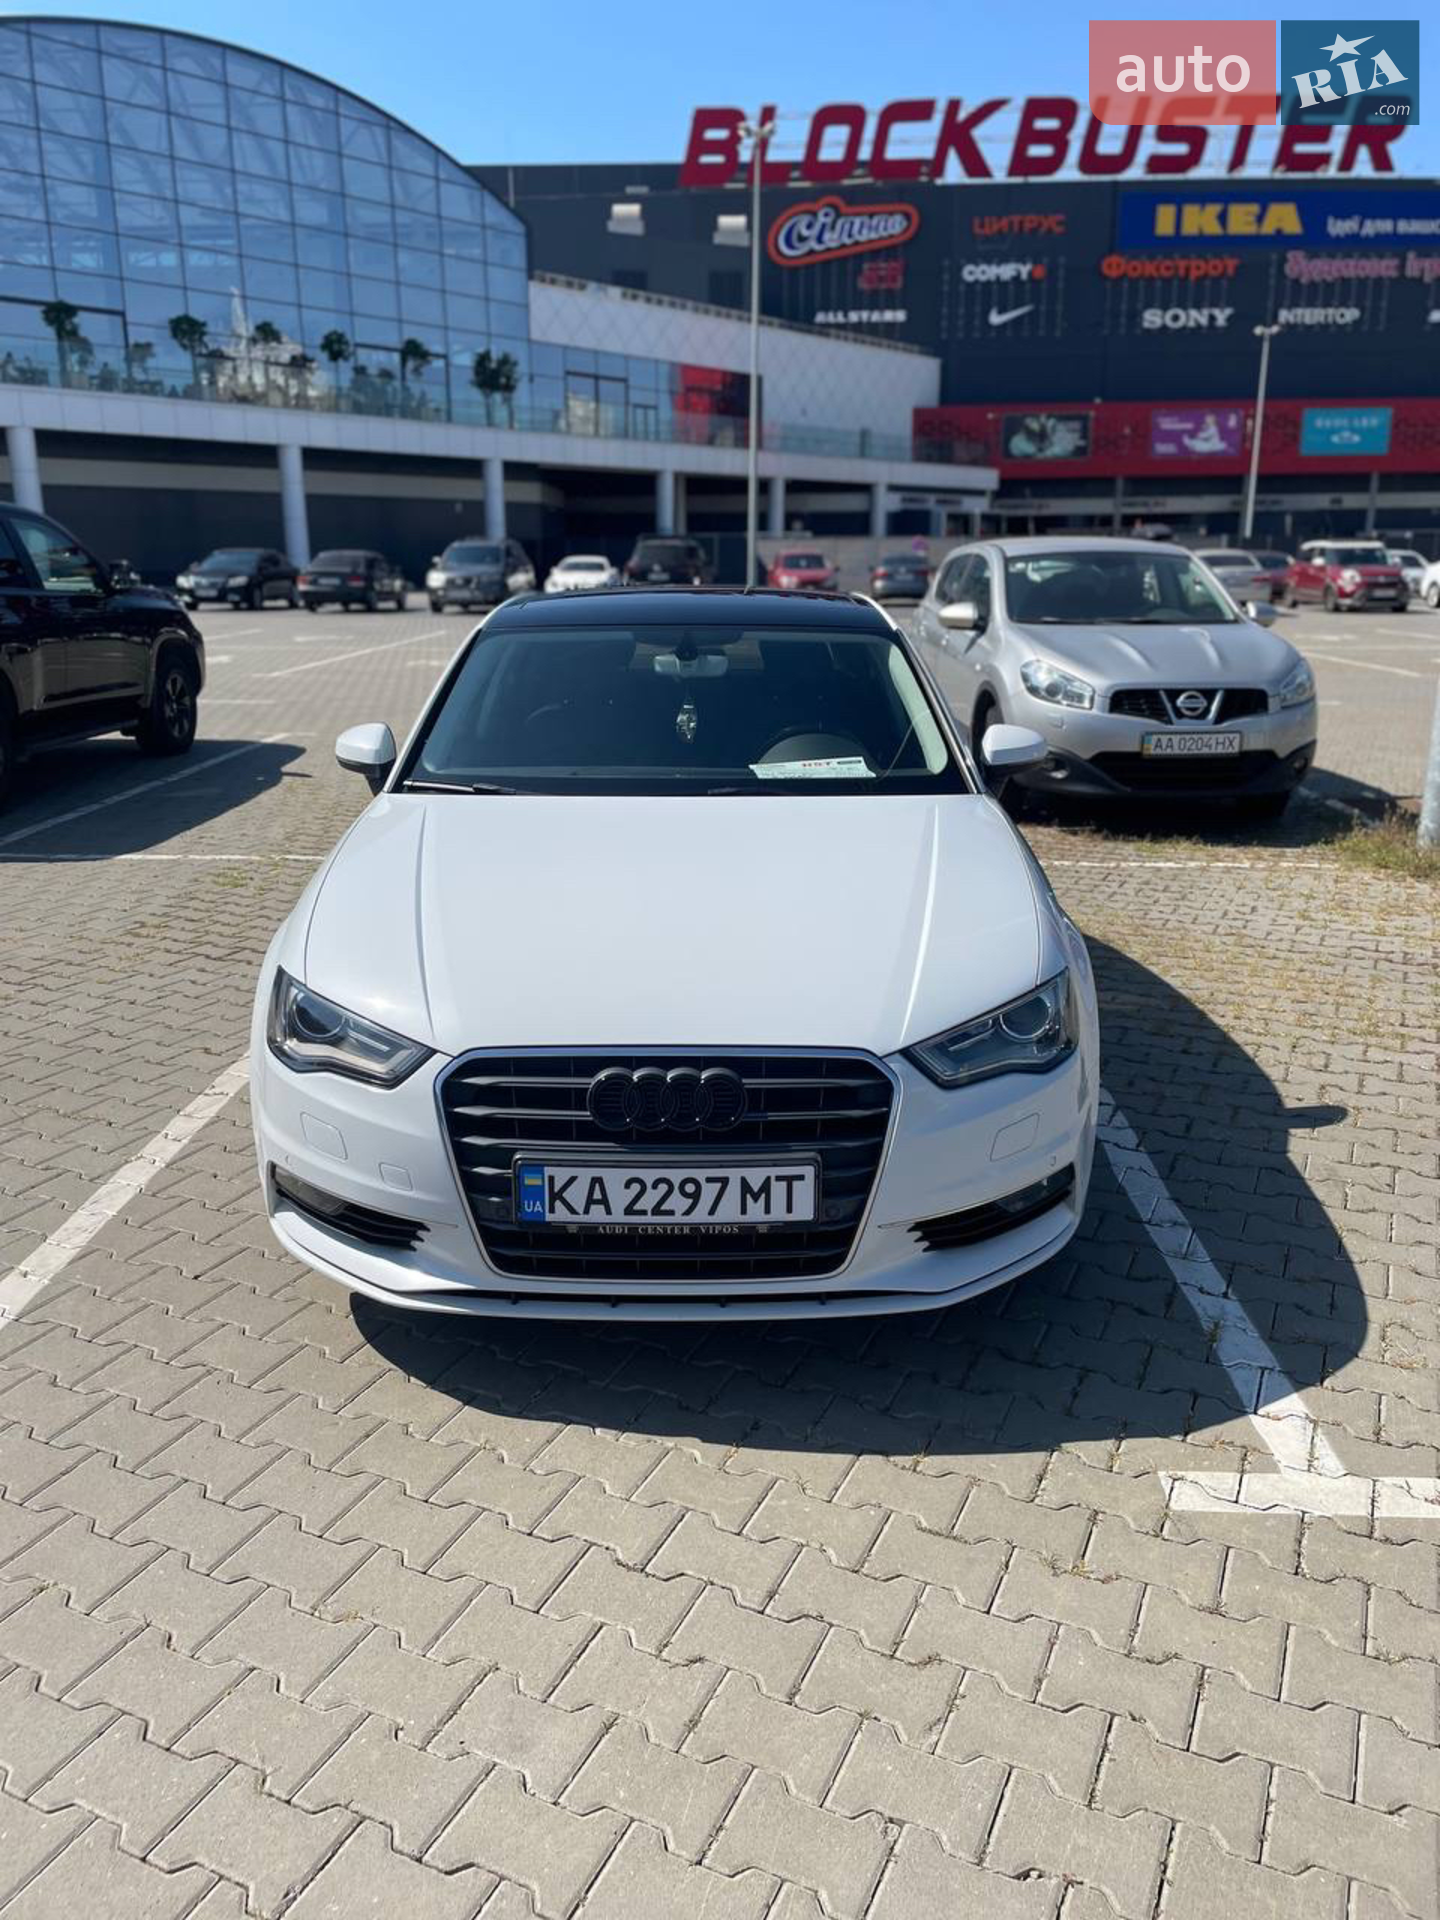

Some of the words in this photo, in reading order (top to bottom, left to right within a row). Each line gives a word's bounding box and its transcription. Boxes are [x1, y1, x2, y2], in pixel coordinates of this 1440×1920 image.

[678, 95, 1412, 187] BLOCKBUSTER
[972, 214, 1066, 236] ЦИТРУС
[1154, 202, 1303, 236] IKEA
[962, 262, 1032, 283] COMFY
[1101, 254, 1240, 281] Фокстрот
[1142, 307, 1234, 329] SONY
[1153, 737, 1174, 752] AA
[1178, 736, 1213, 752] 0204
[1214, 735, 1237, 751] HX
[548, 1175, 613, 1216] KA
[623, 1176, 730, 1216] 2297
[740, 1174, 805, 1216] MT
[524, 1200, 543, 1213] UA
[598, 1225, 629, 1234] AUDI
[638, 1225, 690, 1234] CENTER
